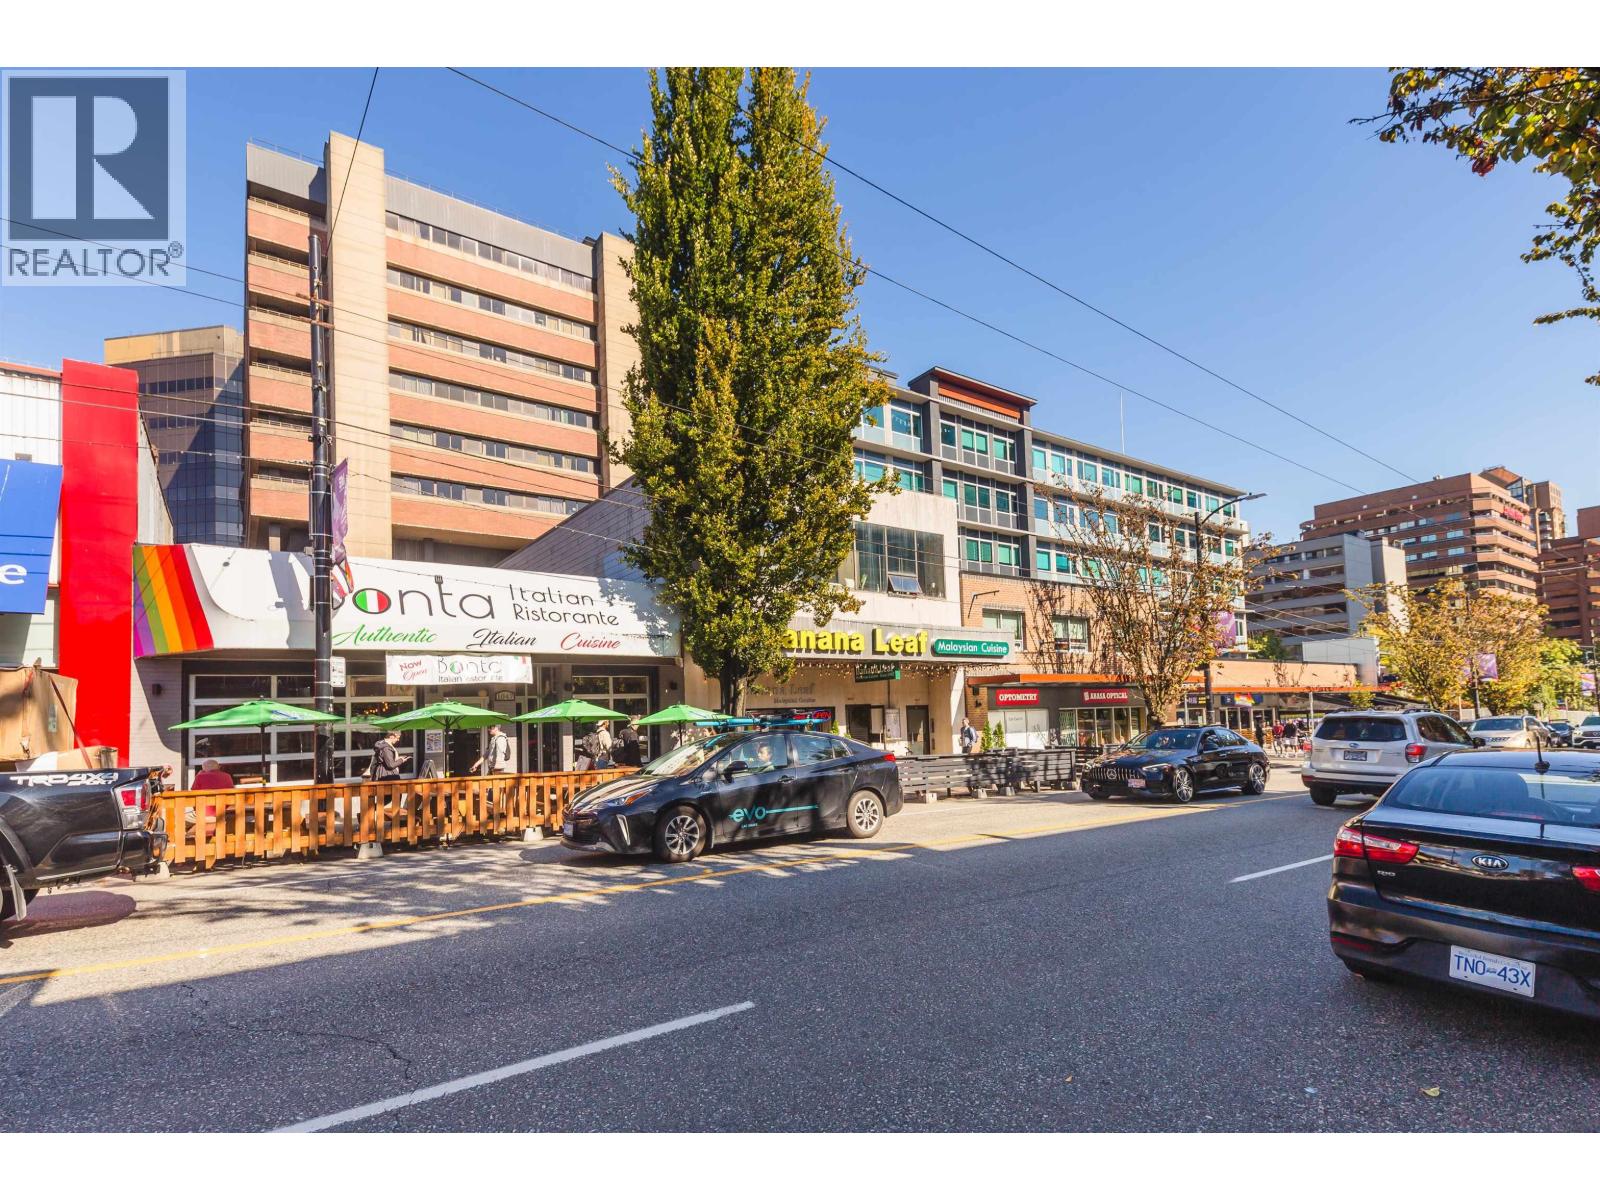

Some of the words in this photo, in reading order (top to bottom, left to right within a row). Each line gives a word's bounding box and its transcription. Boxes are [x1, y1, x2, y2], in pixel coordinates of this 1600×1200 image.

[509, 583, 594, 607] Italian
[513, 603, 620, 627] Ristorante
[332, 624, 439, 646] Authentic
[466, 627, 537, 650] Italian
[560, 632, 622, 651] Cuisine
[873, 628, 929, 655] Leaf
[938, 642, 979, 653] Malaysian
[982, 643, 1008, 654] Cuisine
[438, 675, 463, 683] Italian
[999, 693, 1038, 701] OPTOMETRY
[730, 806, 766, 822] evo
[1478, 857, 1502, 868] KIA
